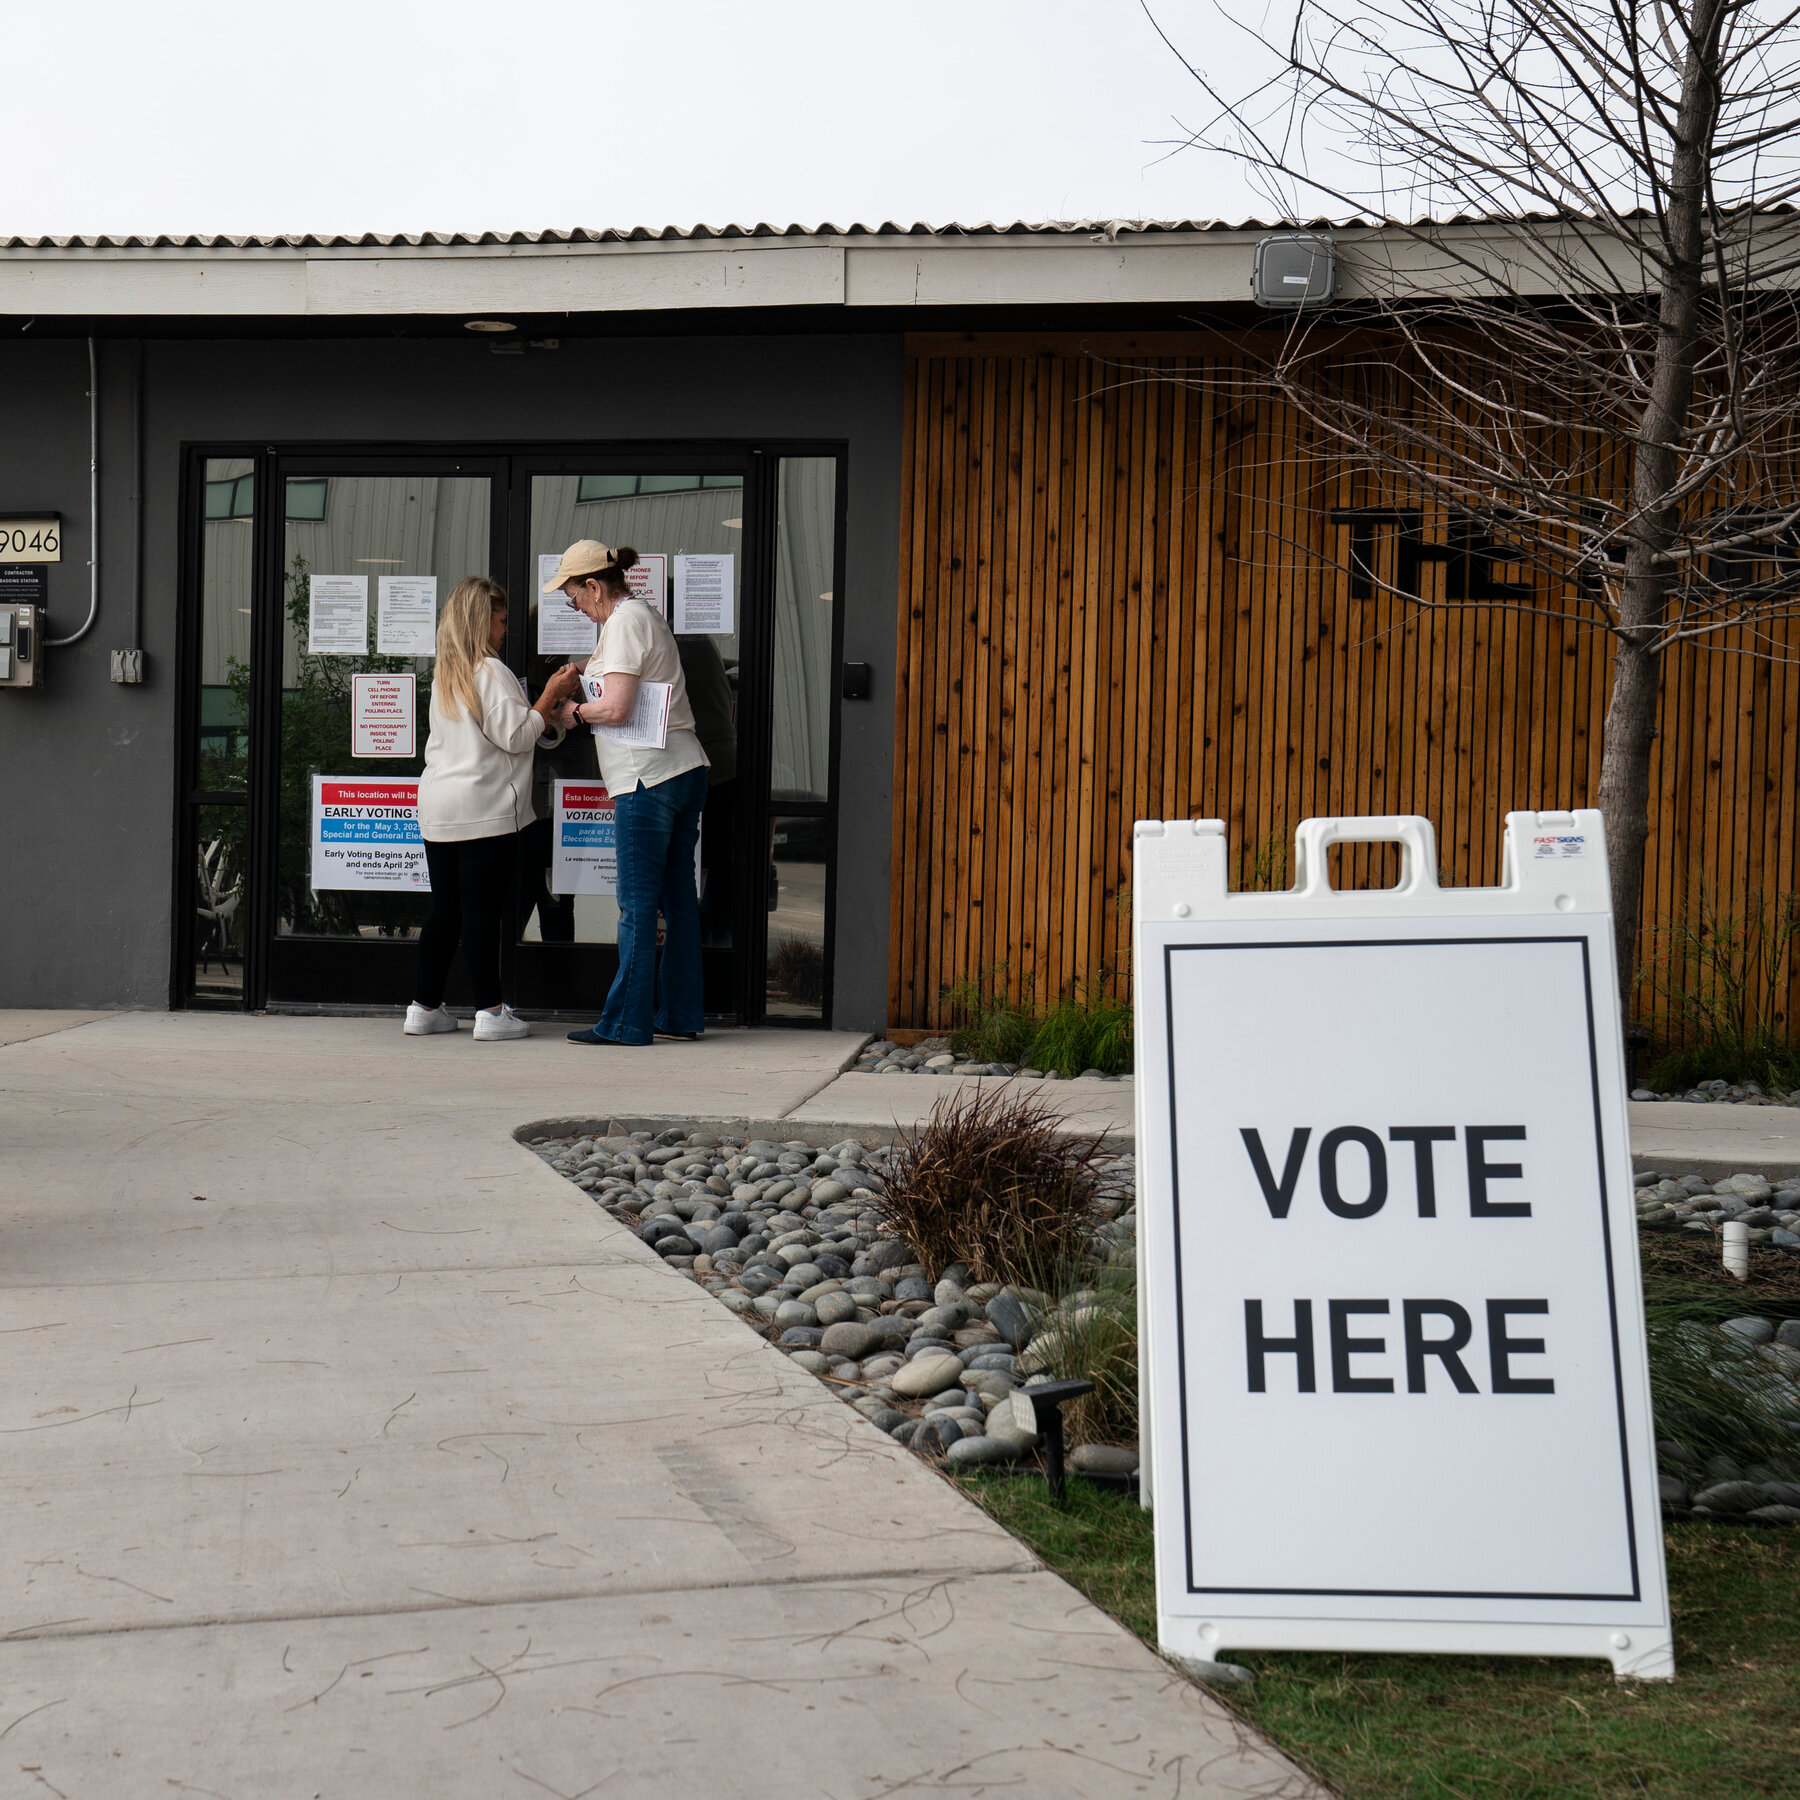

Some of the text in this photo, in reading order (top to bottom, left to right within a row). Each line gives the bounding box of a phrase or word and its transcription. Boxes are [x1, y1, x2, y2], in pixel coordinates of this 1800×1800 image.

[0, 529, 58, 553] 9046
[1330, 507, 1531, 600] THE
[338, 790, 417, 799] This location will be
[565, 794, 581, 802] Ésta
[324, 807, 364, 818] EARLY
[366, 808, 412, 819] VOTING
[344, 822, 355, 830] for
[357, 822, 371, 830] the
[374, 823, 392, 831] May
[393, 823, 401, 831] 3,
[322, 831, 352, 840] Special
[354, 831, 370, 839] and
[371, 832, 404, 840] General
[579, 828, 595, 836] para
[562, 835, 603, 843] Elecciones
[1533, 836, 1585, 844] FASTSIGNS
[324, 850, 424, 861] Early Voting Begins April
[362, 861, 382, 869] ends
[383, 861, 403, 870] April
[404, 861, 419, 869] 29th
[1239, 1124, 1532, 1219] VOTE
[1244, 1298, 1555, 1394] HERE
